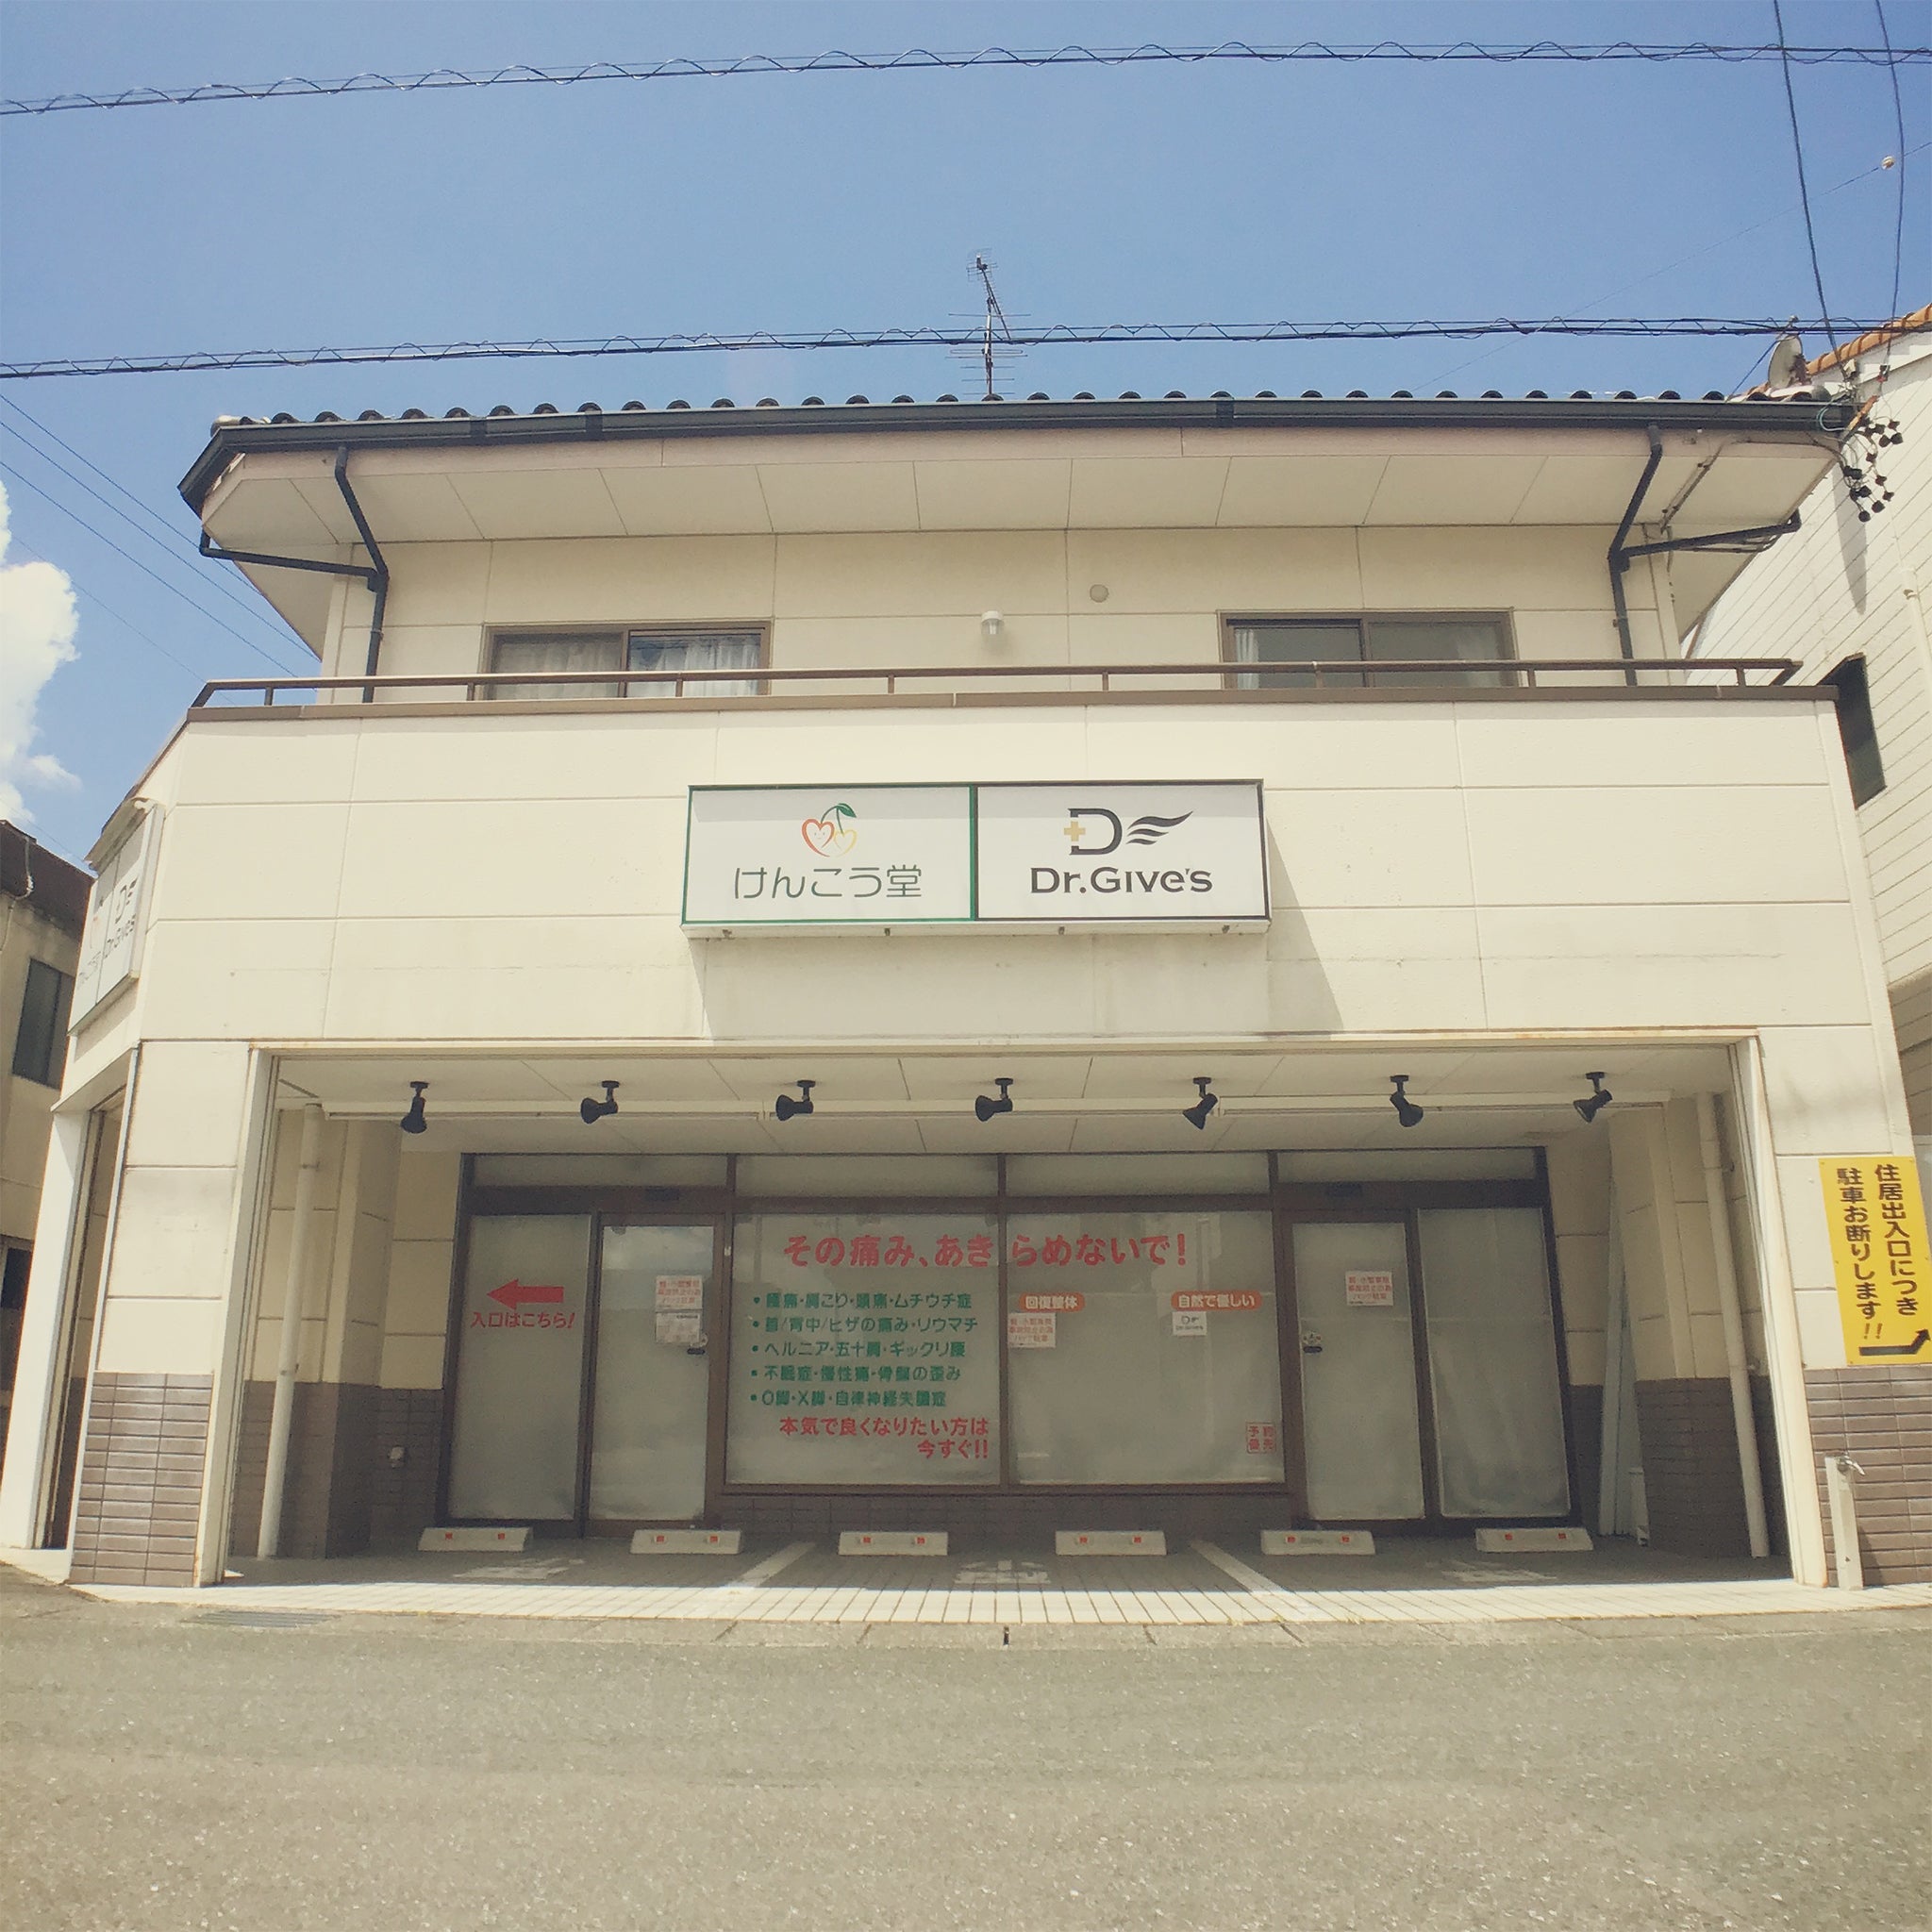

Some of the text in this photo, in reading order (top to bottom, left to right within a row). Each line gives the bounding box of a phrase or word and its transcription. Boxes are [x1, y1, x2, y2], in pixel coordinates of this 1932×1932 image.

[734, 864, 923, 899] けんこう堂
[1030, 866, 1213, 894] Dr.Give's
[1874, 1164, 1920, 1316] 住居出入口につき
[1837, 1168, 1884, 1341] 駐車お断りします!!
[471, 1311, 575, 1329] 入口はこちら!
[779, 1417, 989, 1436] 本気で良くなりたい方は
[917, 1439, 989, 1459] 今すぐ!!
